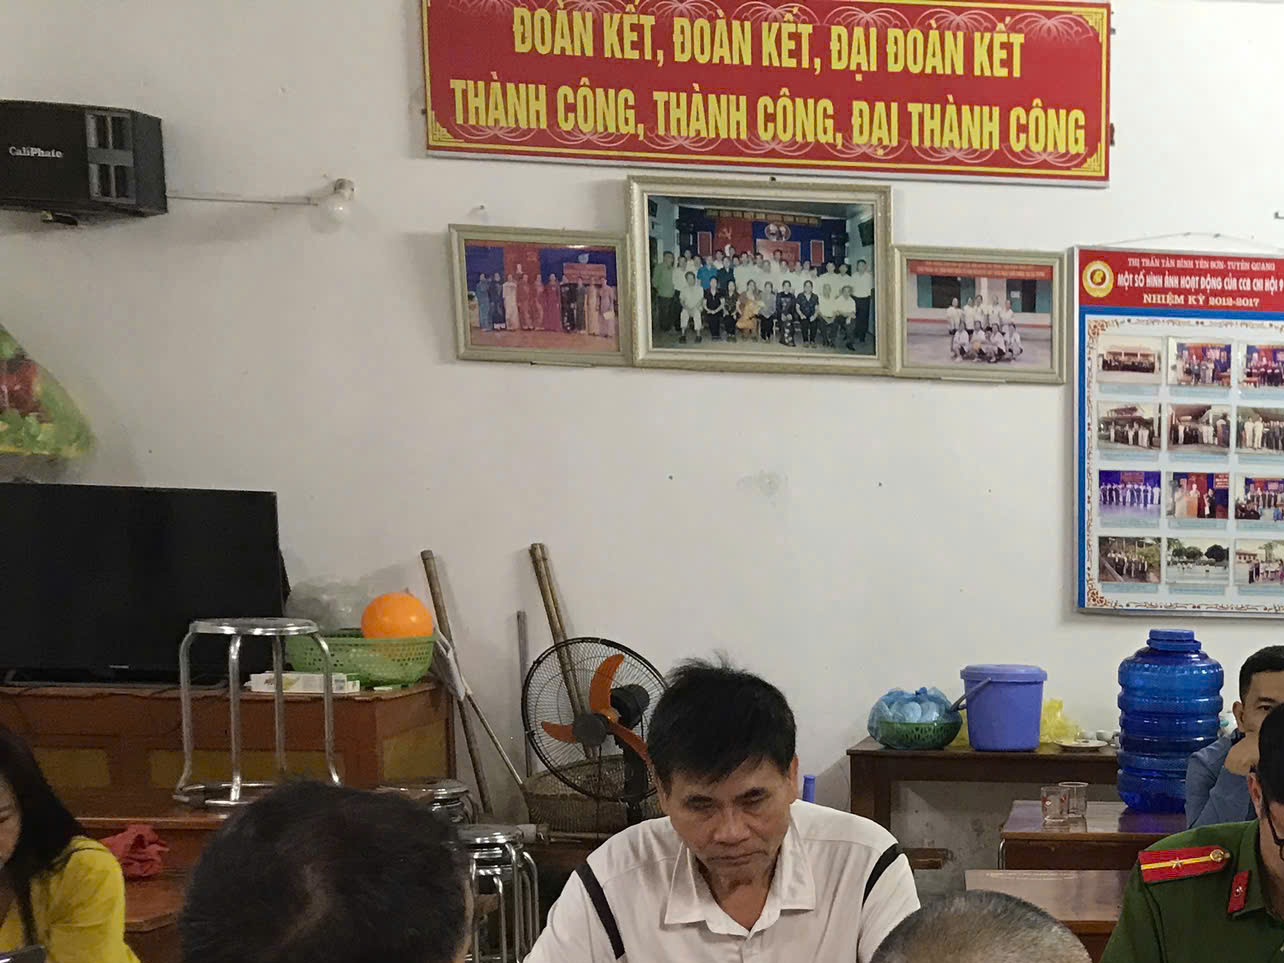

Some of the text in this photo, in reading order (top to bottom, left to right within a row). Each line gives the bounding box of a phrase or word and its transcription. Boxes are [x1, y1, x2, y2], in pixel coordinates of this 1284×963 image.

[513, 0, 1025, 82] ĐOÀN KẾT, ĐOÀN KẾT, ĐẠI ĐOÀN KẾT
[450, 71, 1086, 156] THÀNH CÔNG, THÀNH CÔNG, ĐẠI THÀNH CÔNG
[1117, 269, 1133, 291] MỘT
[1135, 269, 1145, 288] SỐ
[1146, 271, 1163, 288] HÌNH
[1164, 270, 1179, 288] ẢNH
[1200, 273, 1222, 293] ĐỘNG
[1265, 275, 1278, 296] HỘI
[1143, 291, 1185, 306] NHIỆM
[1188, 292, 1206, 305] KỲ
